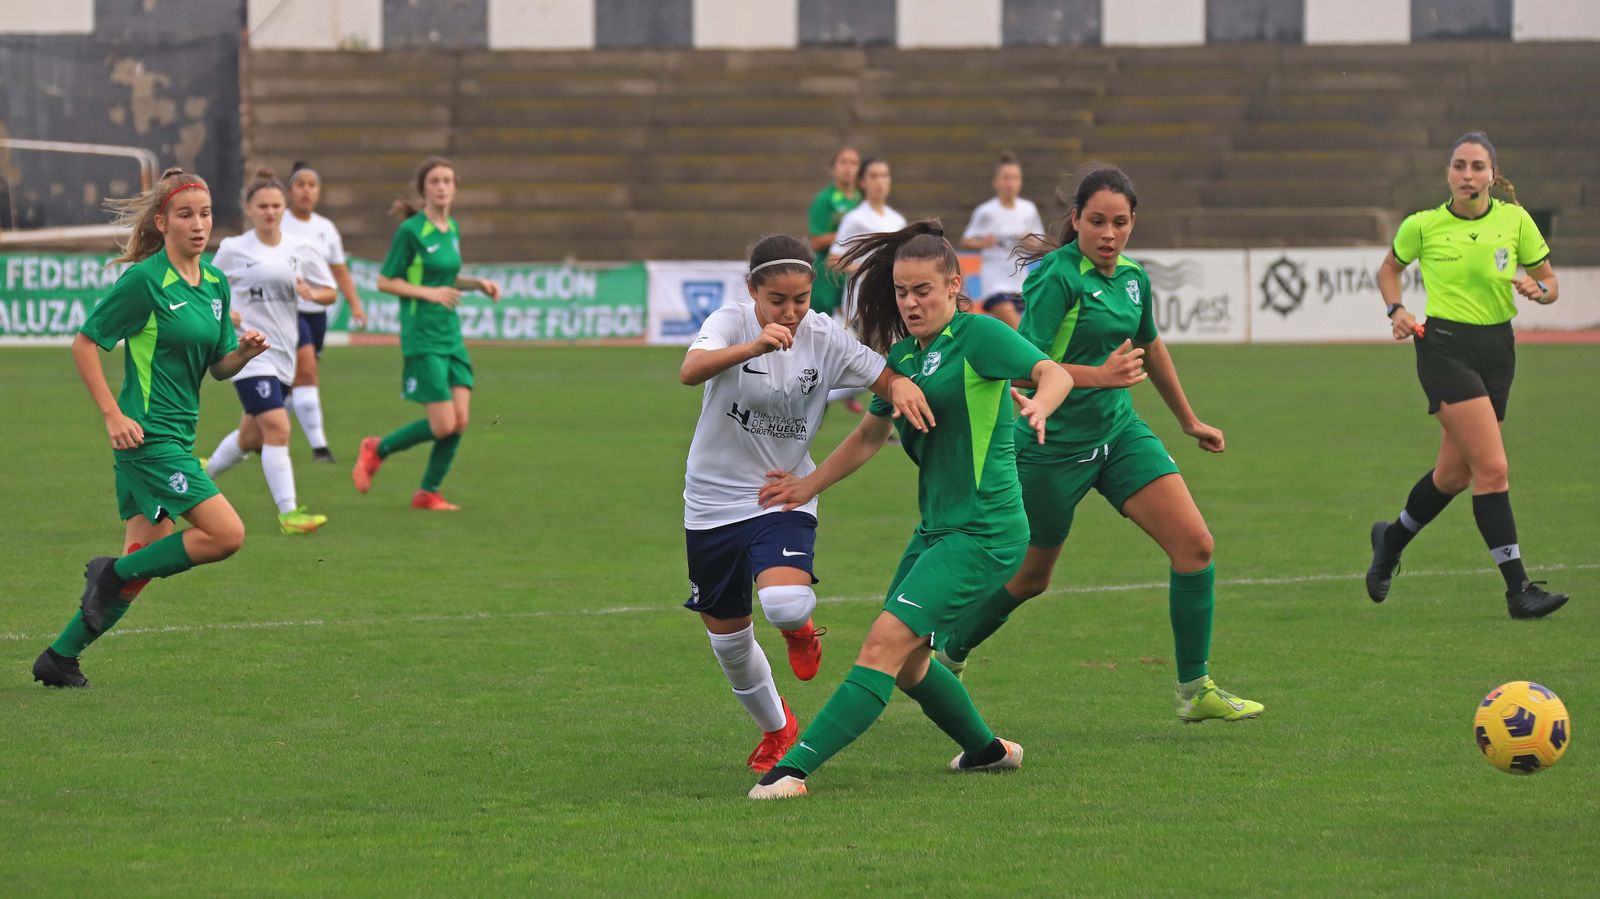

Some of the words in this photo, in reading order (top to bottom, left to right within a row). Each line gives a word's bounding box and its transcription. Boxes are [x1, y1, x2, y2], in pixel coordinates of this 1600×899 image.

[6, 257, 134, 290] FEDERA
[502, 306, 541, 338] DE
[751, 419, 764, 429] DE
[768, 423, 807, 434] HUELVA
